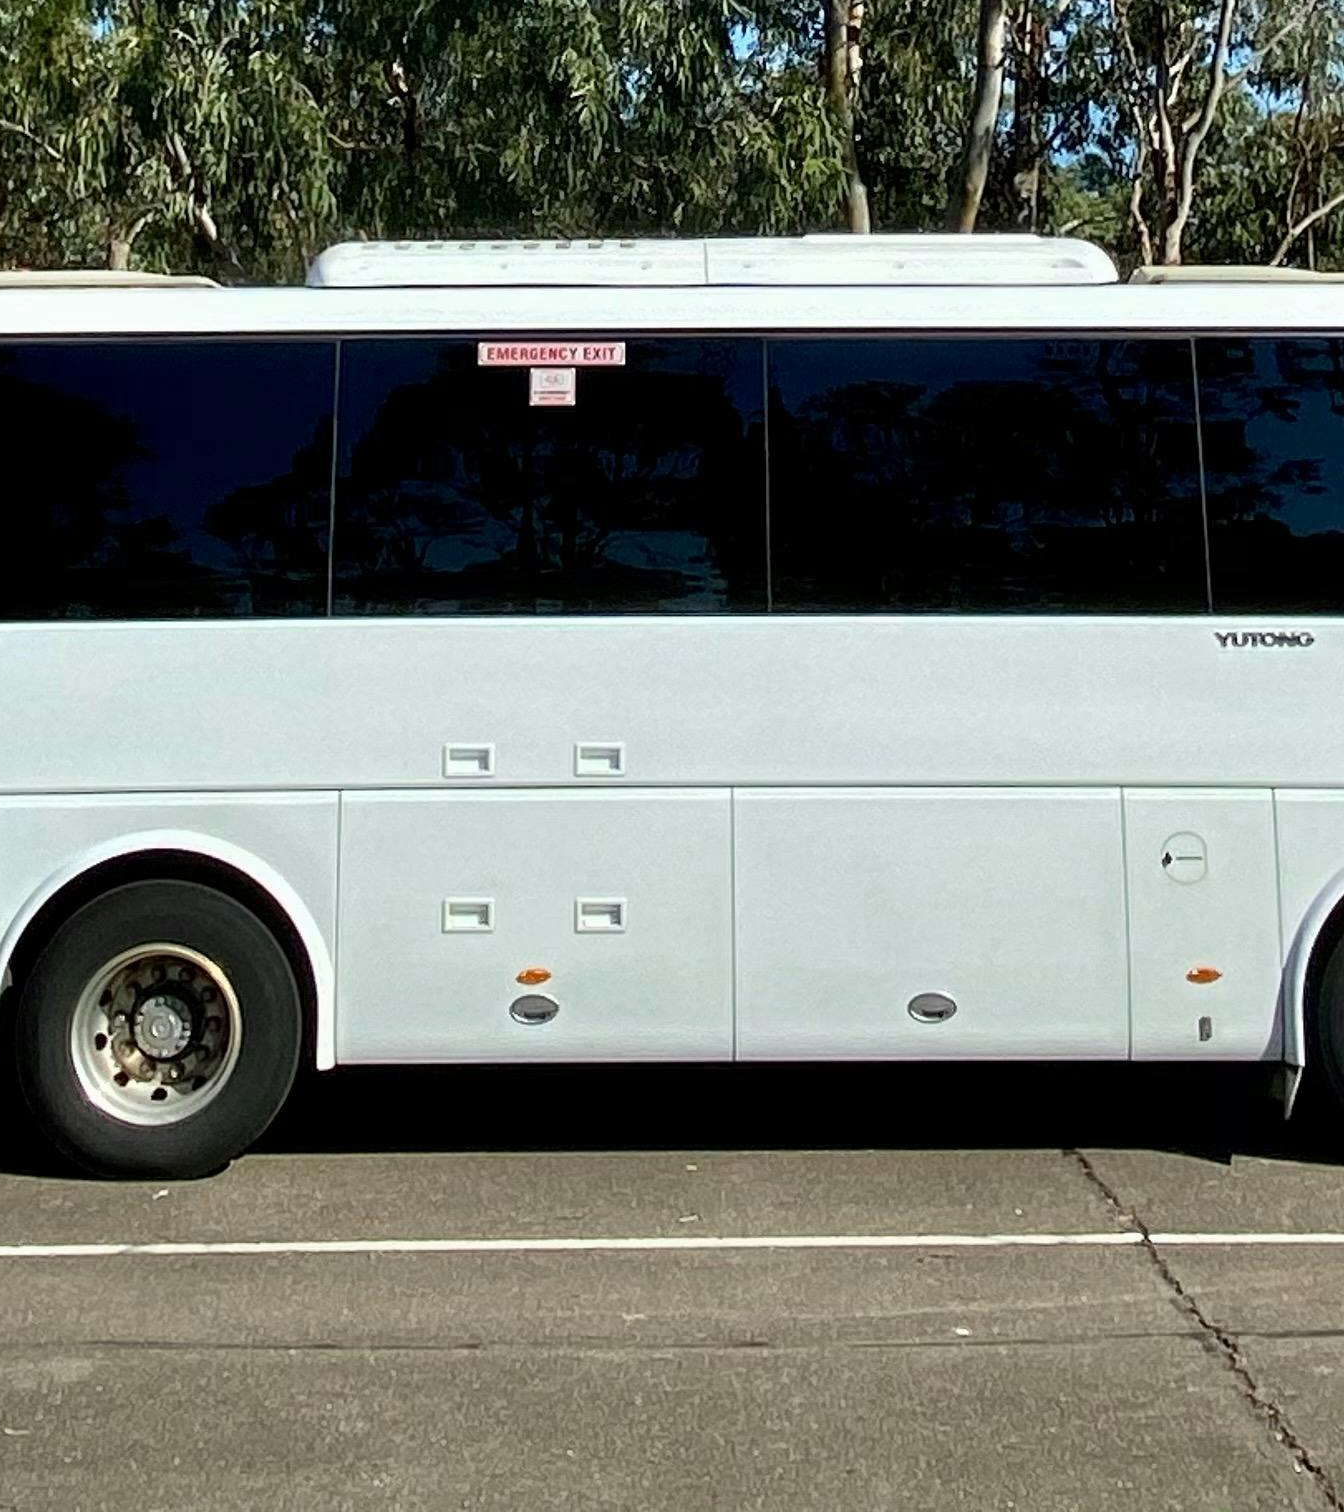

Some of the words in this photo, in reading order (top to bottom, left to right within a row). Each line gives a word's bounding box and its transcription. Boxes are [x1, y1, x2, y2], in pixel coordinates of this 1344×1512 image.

[486, 347, 578, 361] EMERGENCY
[583, 346, 617, 361] EXIT
[1214, 631, 1315, 648] YUTONG
